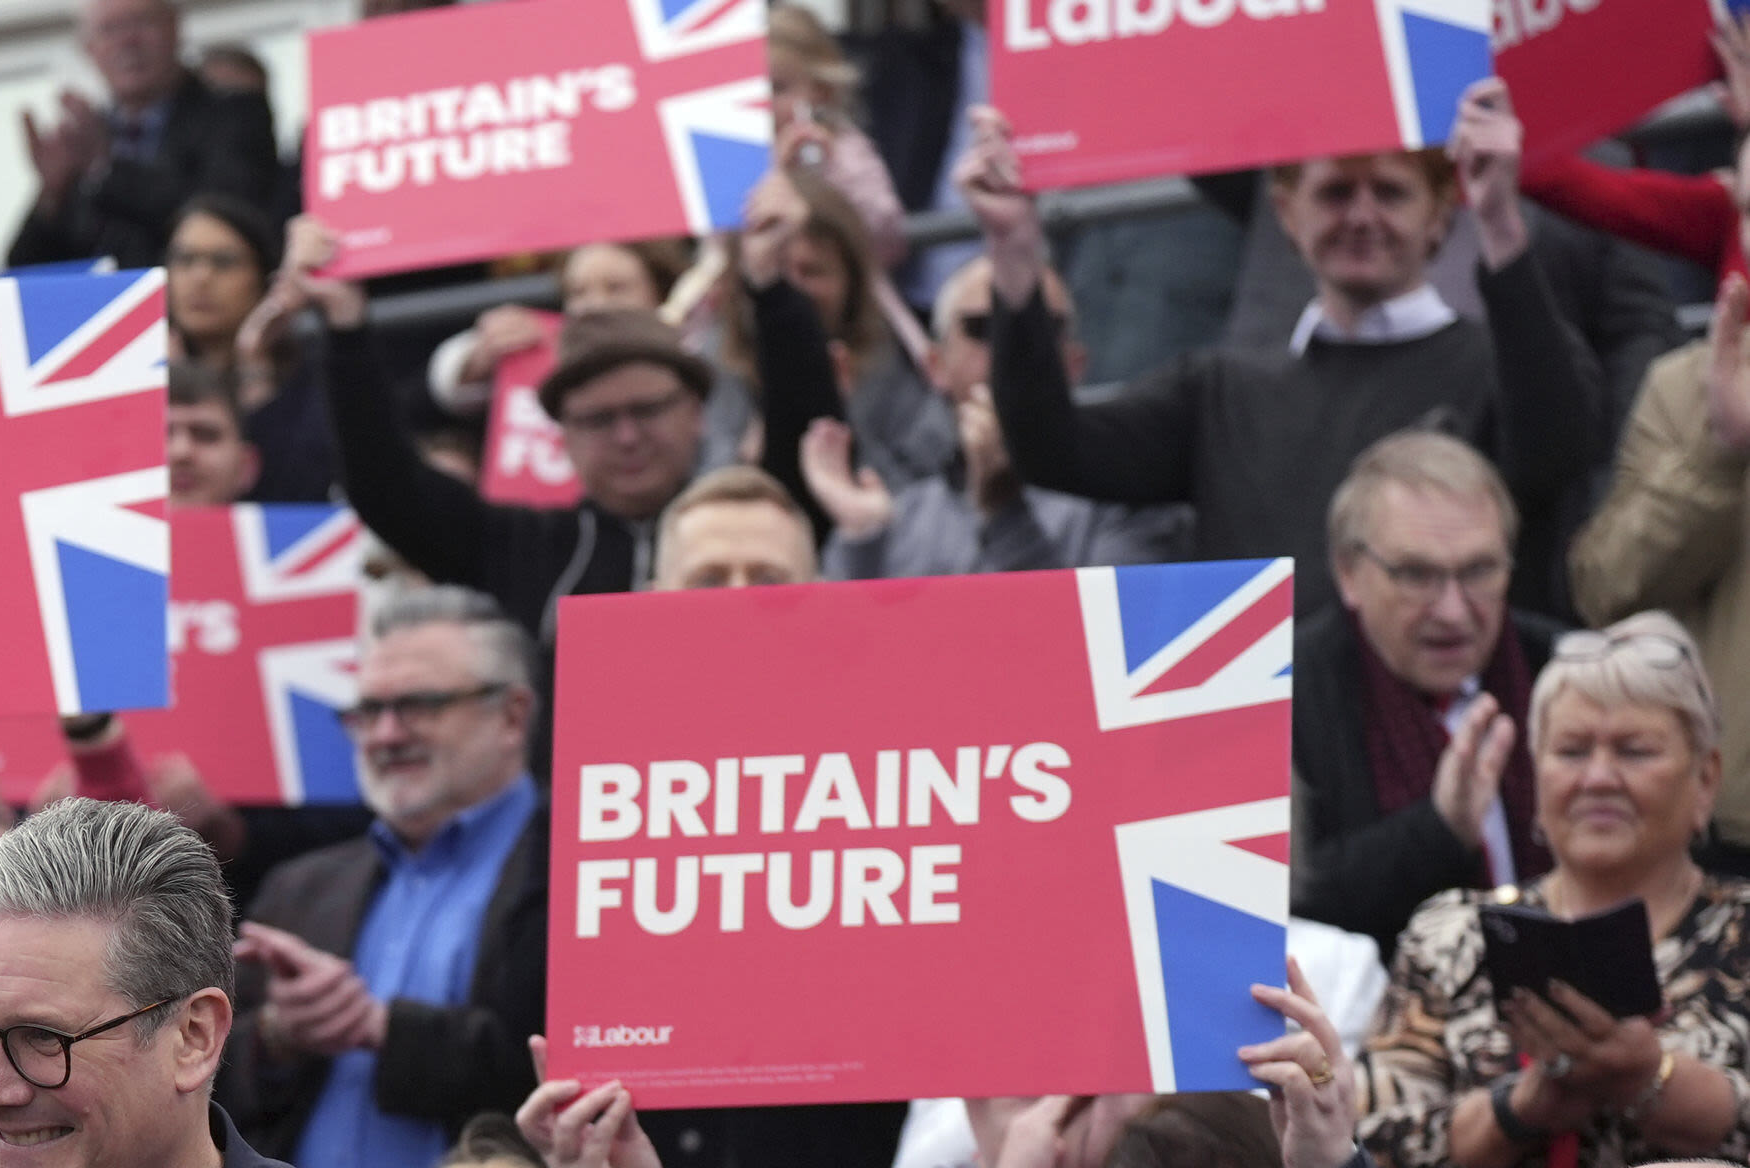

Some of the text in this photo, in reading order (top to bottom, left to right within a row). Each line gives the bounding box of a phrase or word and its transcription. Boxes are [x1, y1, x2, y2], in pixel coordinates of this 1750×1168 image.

[318, 62, 637, 151] BRITAIN'S
[318, 119, 572, 200] FUTURE
[578, 742, 1072, 842] BRITAIN'S
[575, 845, 961, 938] FUTURE
[594, 1025, 673, 1047] Labour
